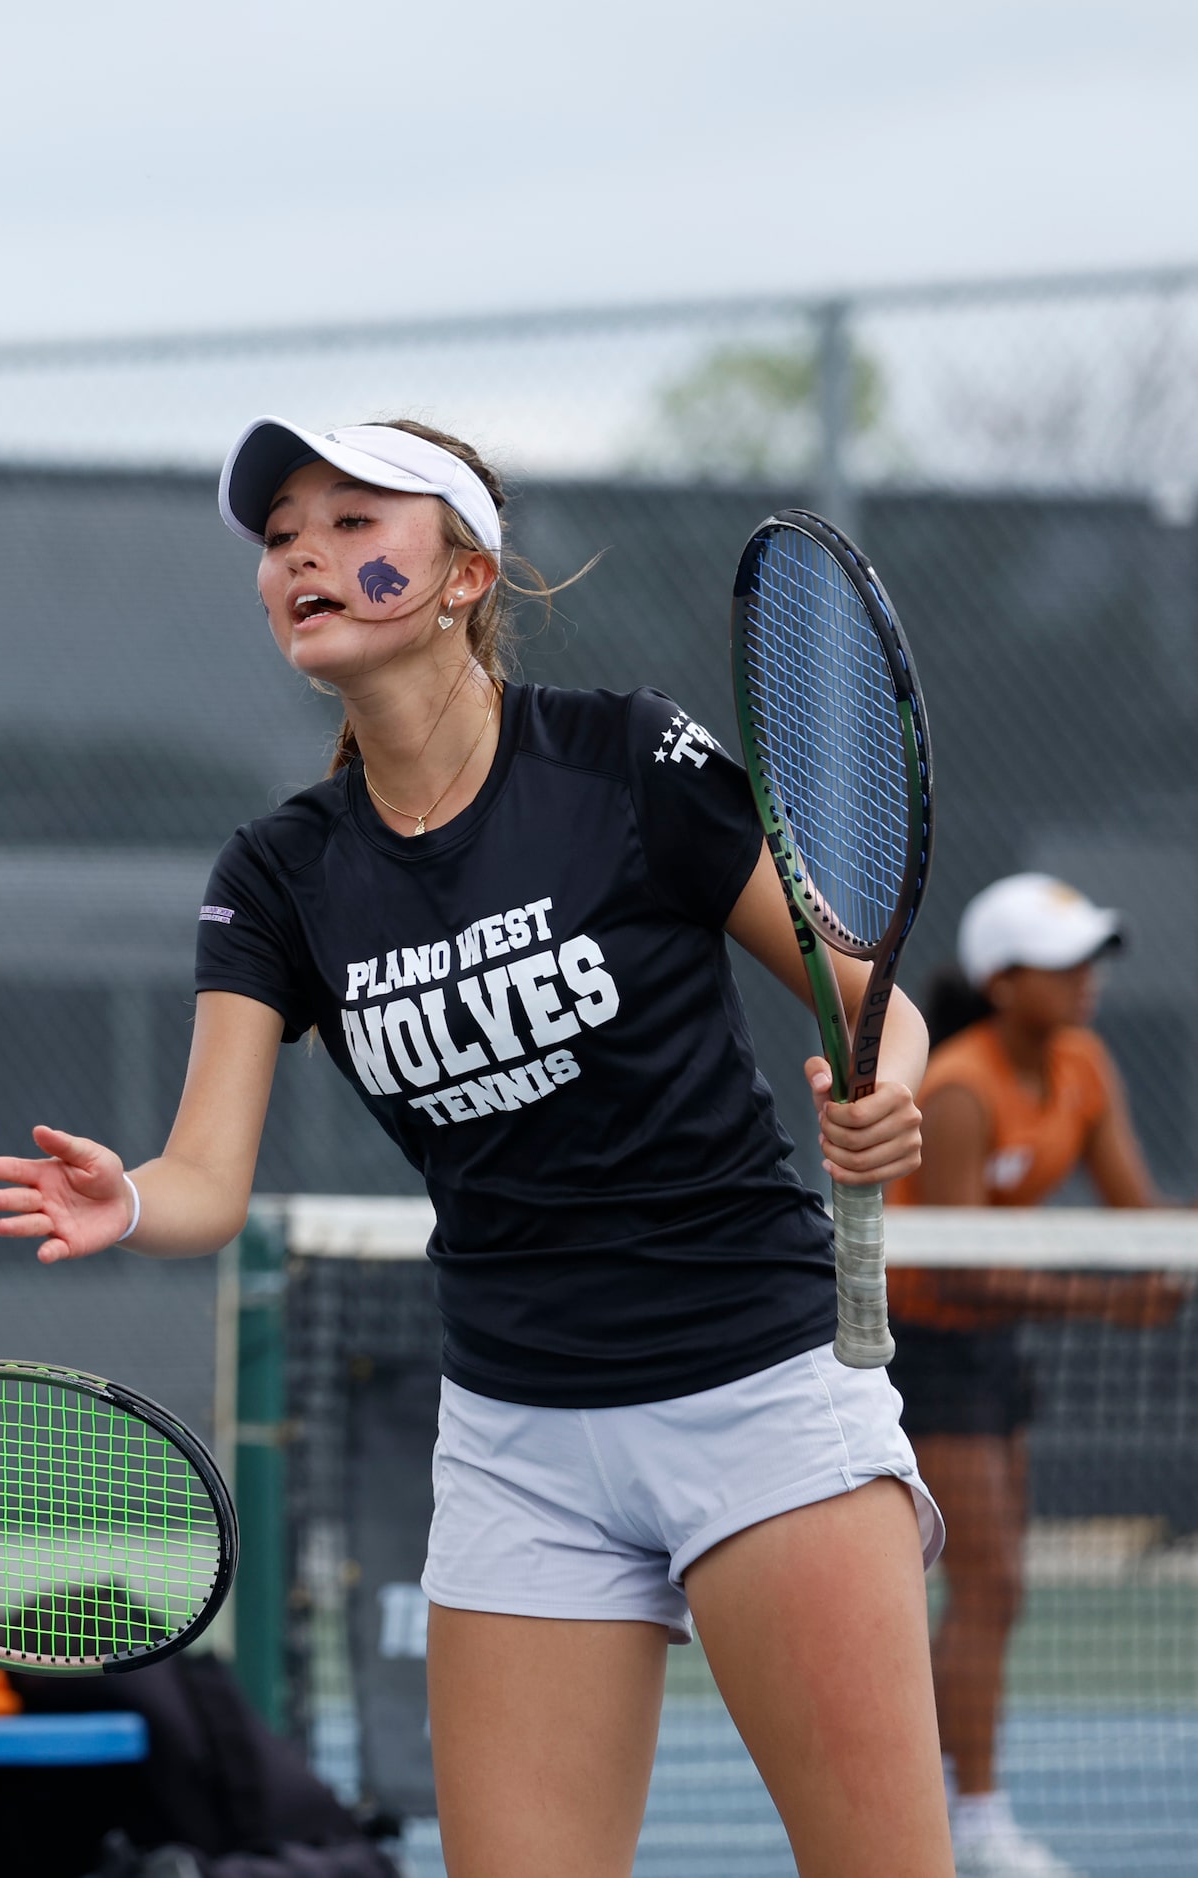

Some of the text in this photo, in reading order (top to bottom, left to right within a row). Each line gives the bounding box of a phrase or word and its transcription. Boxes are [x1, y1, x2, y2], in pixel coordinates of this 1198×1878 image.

[345, 896, 552, 1001] PLANO WEST
[341, 934, 620, 1096] WOLVES
[407, 1049, 581, 1127] TENNIS
